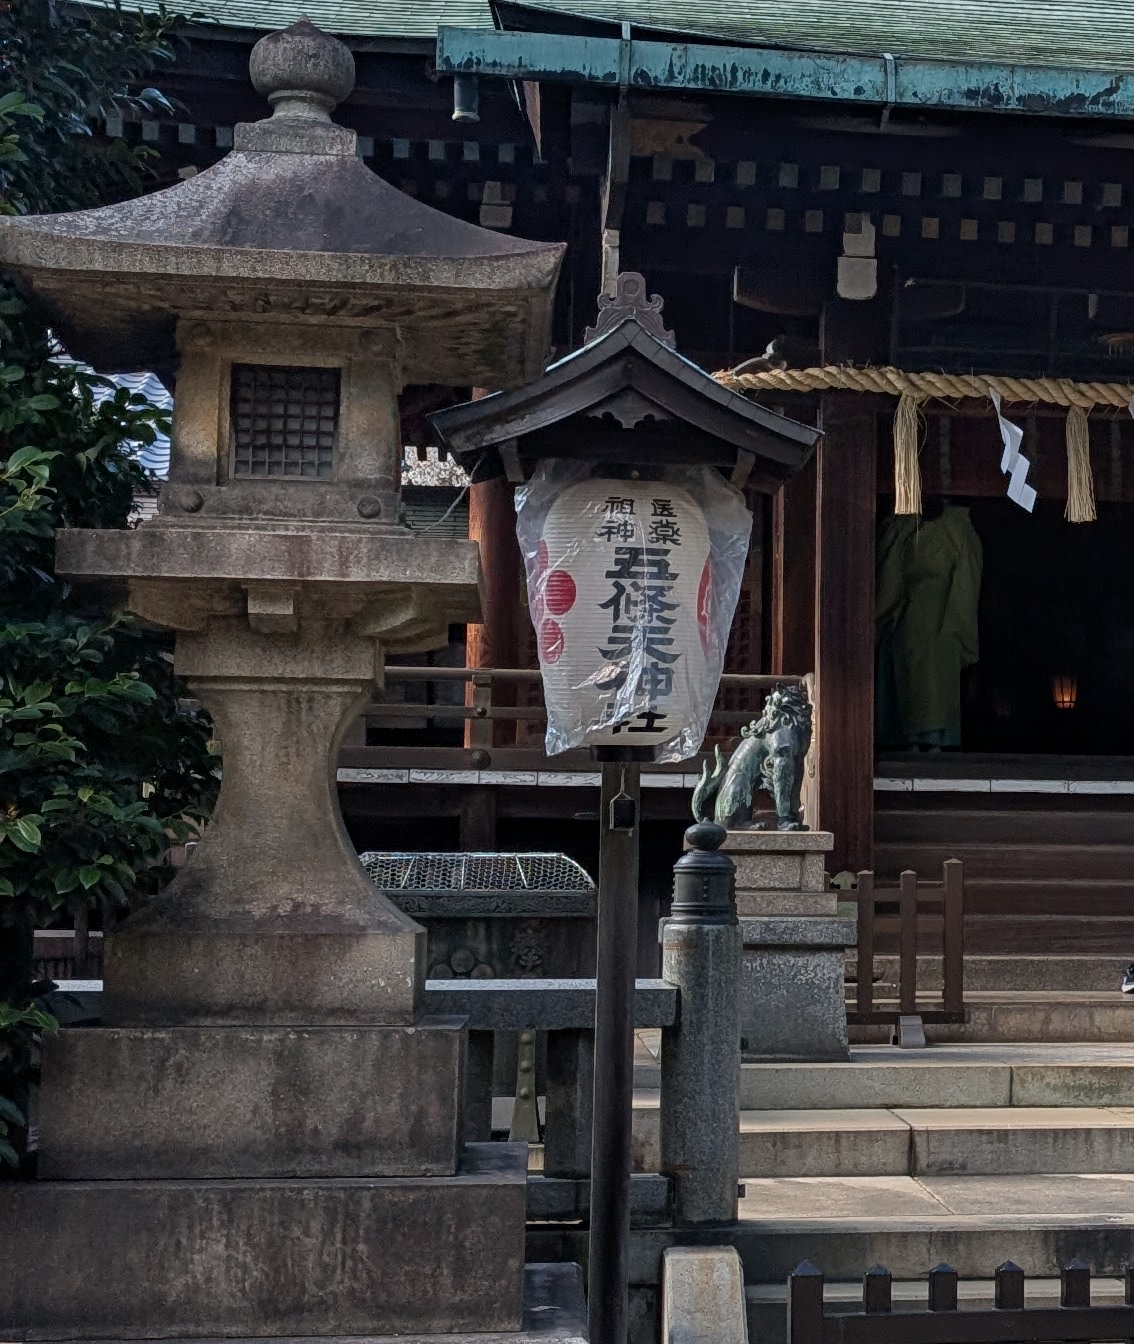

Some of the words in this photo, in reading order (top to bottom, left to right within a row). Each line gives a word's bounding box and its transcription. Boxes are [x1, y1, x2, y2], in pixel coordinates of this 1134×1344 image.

[596, 497, 636, 543] 祖神
[648, 499, 682, 546] 医薬
[595, 546, 683, 735] 五條天神社
